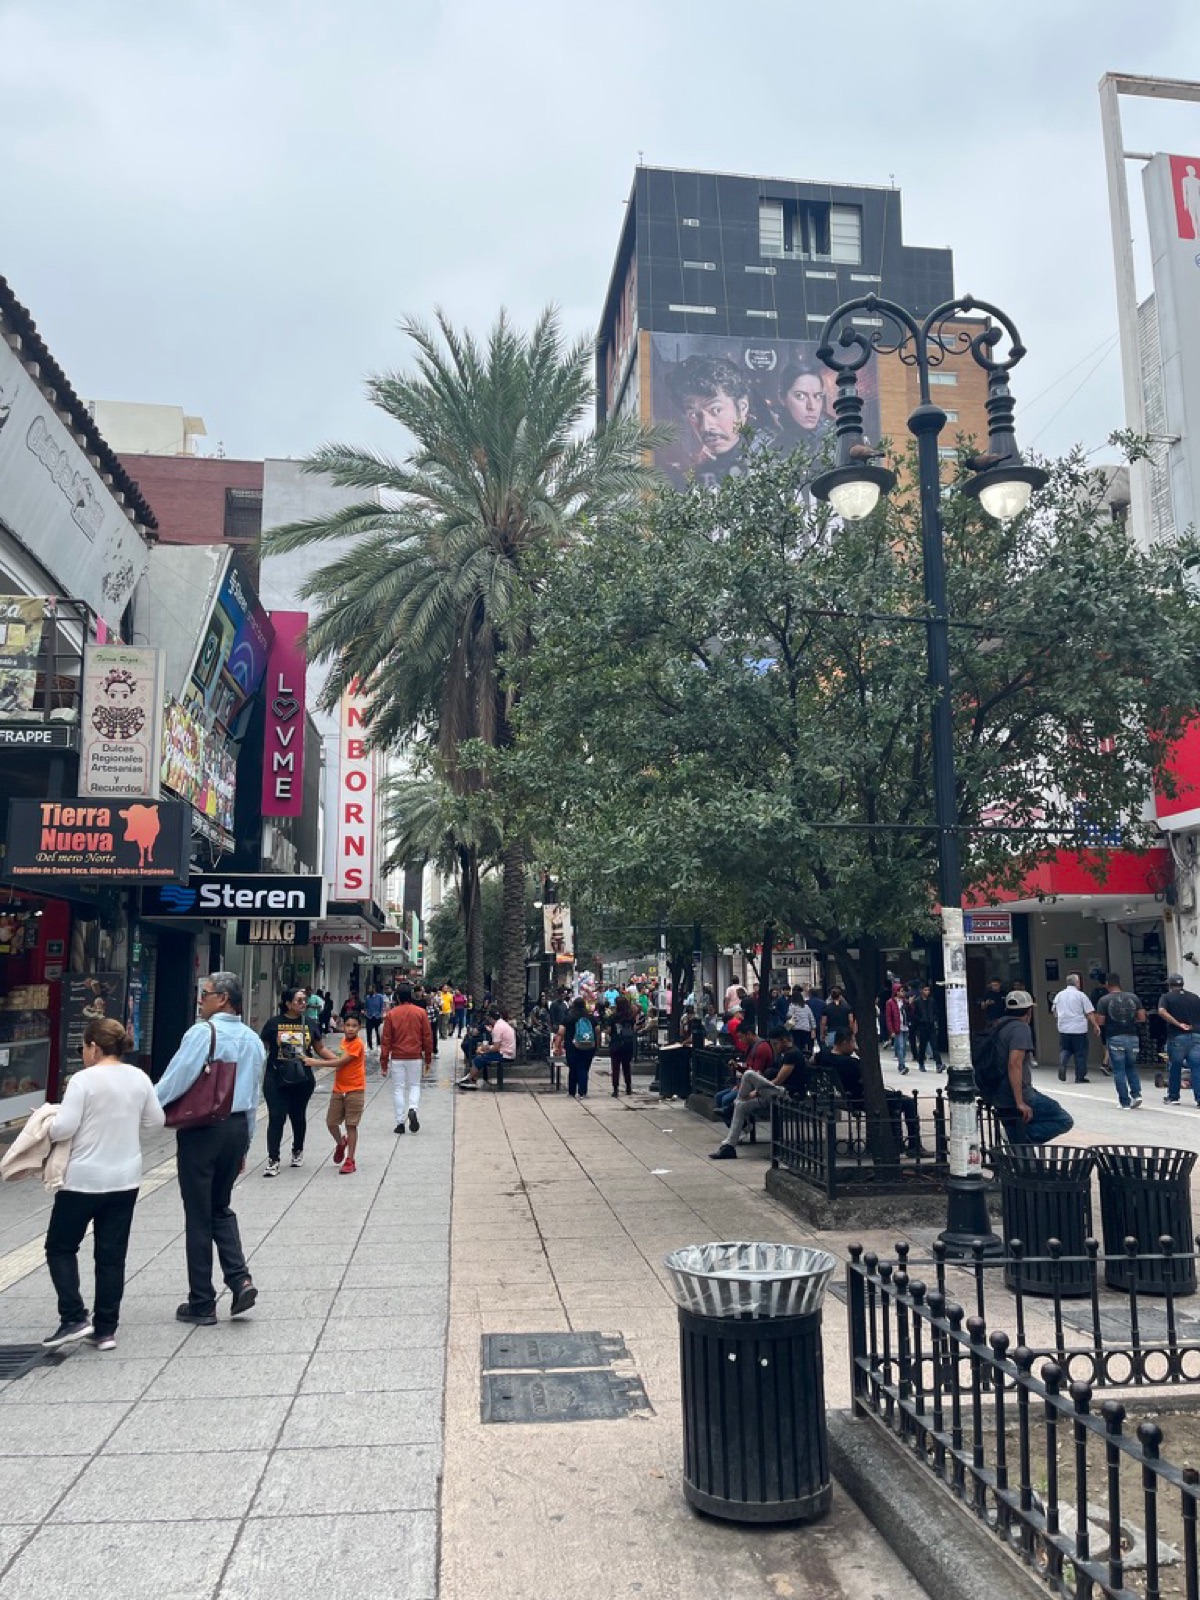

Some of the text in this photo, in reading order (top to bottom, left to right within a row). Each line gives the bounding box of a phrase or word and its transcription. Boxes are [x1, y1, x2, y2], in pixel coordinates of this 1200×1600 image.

[102, 744, 135, 752] Dulces
[91, 753, 143, 764] Regionales
[113, 775, 120, 784] y
[343, 674, 367, 889] ANBORNS
[90, 782, 142, 793] Recuerdos
[40, 802, 111, 827] Tierra
[40, 828, 113, 851] Nueva
[35, 851, 117, 864] Del mero Norte
[199, 882, 306, 909] Steren
